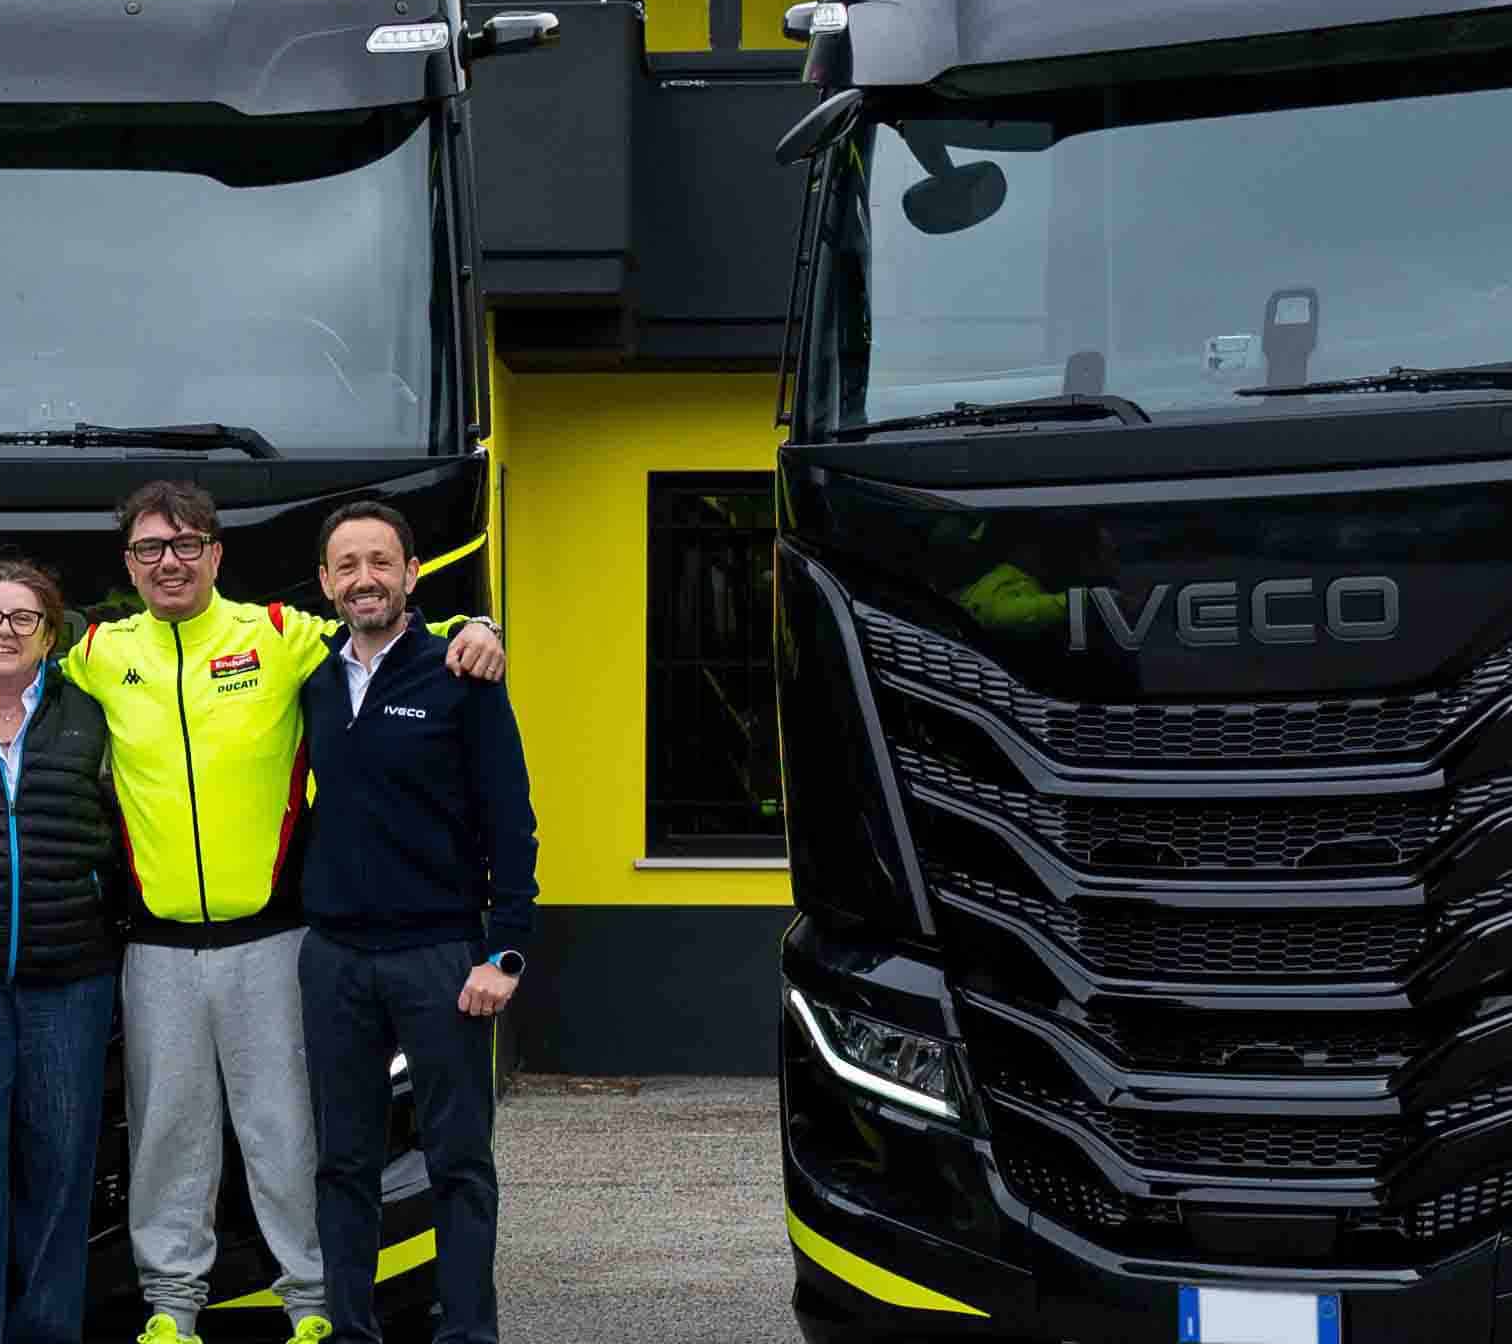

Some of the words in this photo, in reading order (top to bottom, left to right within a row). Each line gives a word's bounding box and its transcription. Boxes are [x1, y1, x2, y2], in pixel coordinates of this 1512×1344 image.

[1067, 575, 1399, 650] IVECO
[218, 677, 258, 693] DUCATI
[384, 705, 426, 719] IVECO
